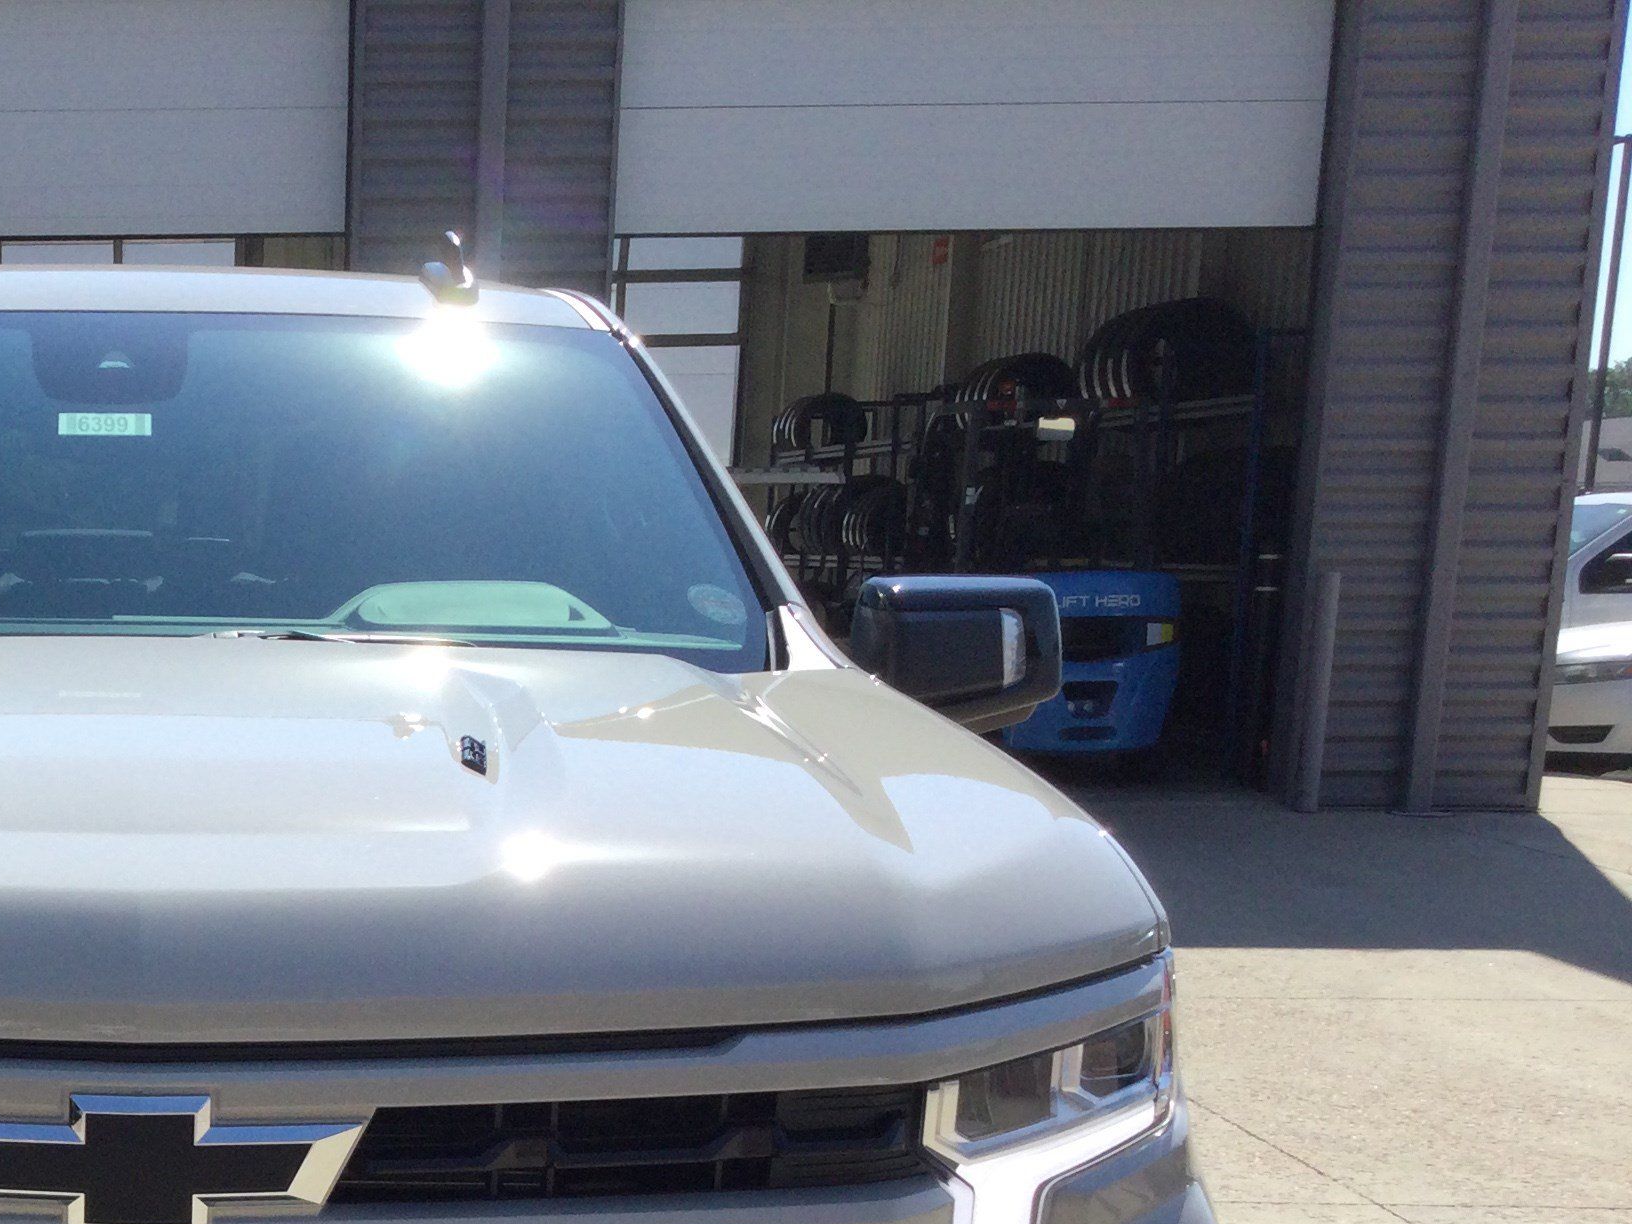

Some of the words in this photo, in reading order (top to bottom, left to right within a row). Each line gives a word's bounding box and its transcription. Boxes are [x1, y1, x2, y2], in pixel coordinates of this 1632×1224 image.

[77, 415, 128, 433] 6399
[1058, 595, 1090, 609] IFT
[1095, 594, 1141, 609] HERO
